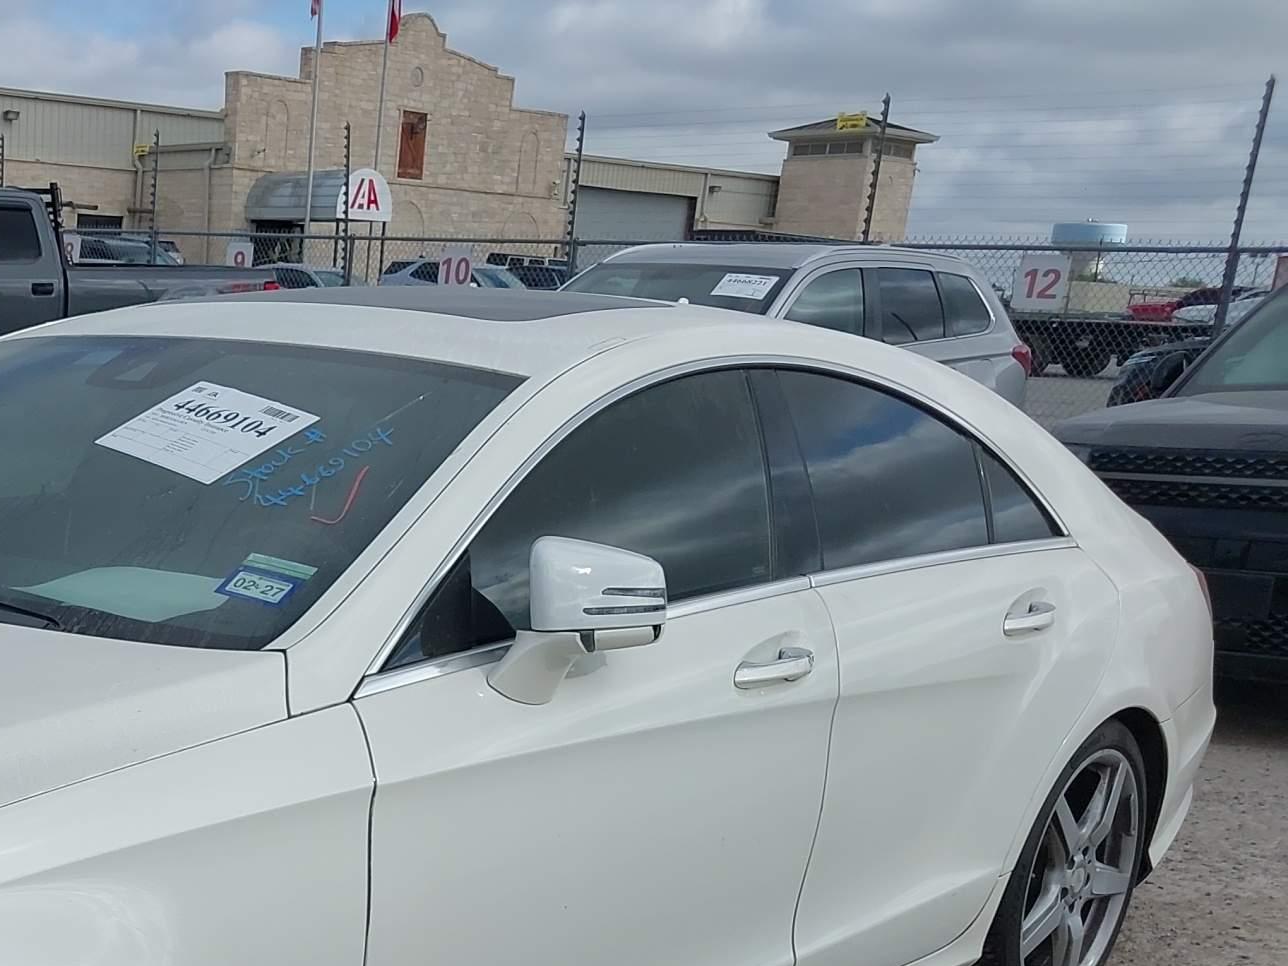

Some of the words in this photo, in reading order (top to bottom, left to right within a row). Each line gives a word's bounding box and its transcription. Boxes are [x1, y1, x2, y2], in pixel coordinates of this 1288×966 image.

[441, 256, 470, 285] 10
[1023, 267, 1062, 300] 12
[173, 399, 277, 438] 44669104
[304, 427, 327, 446] #
